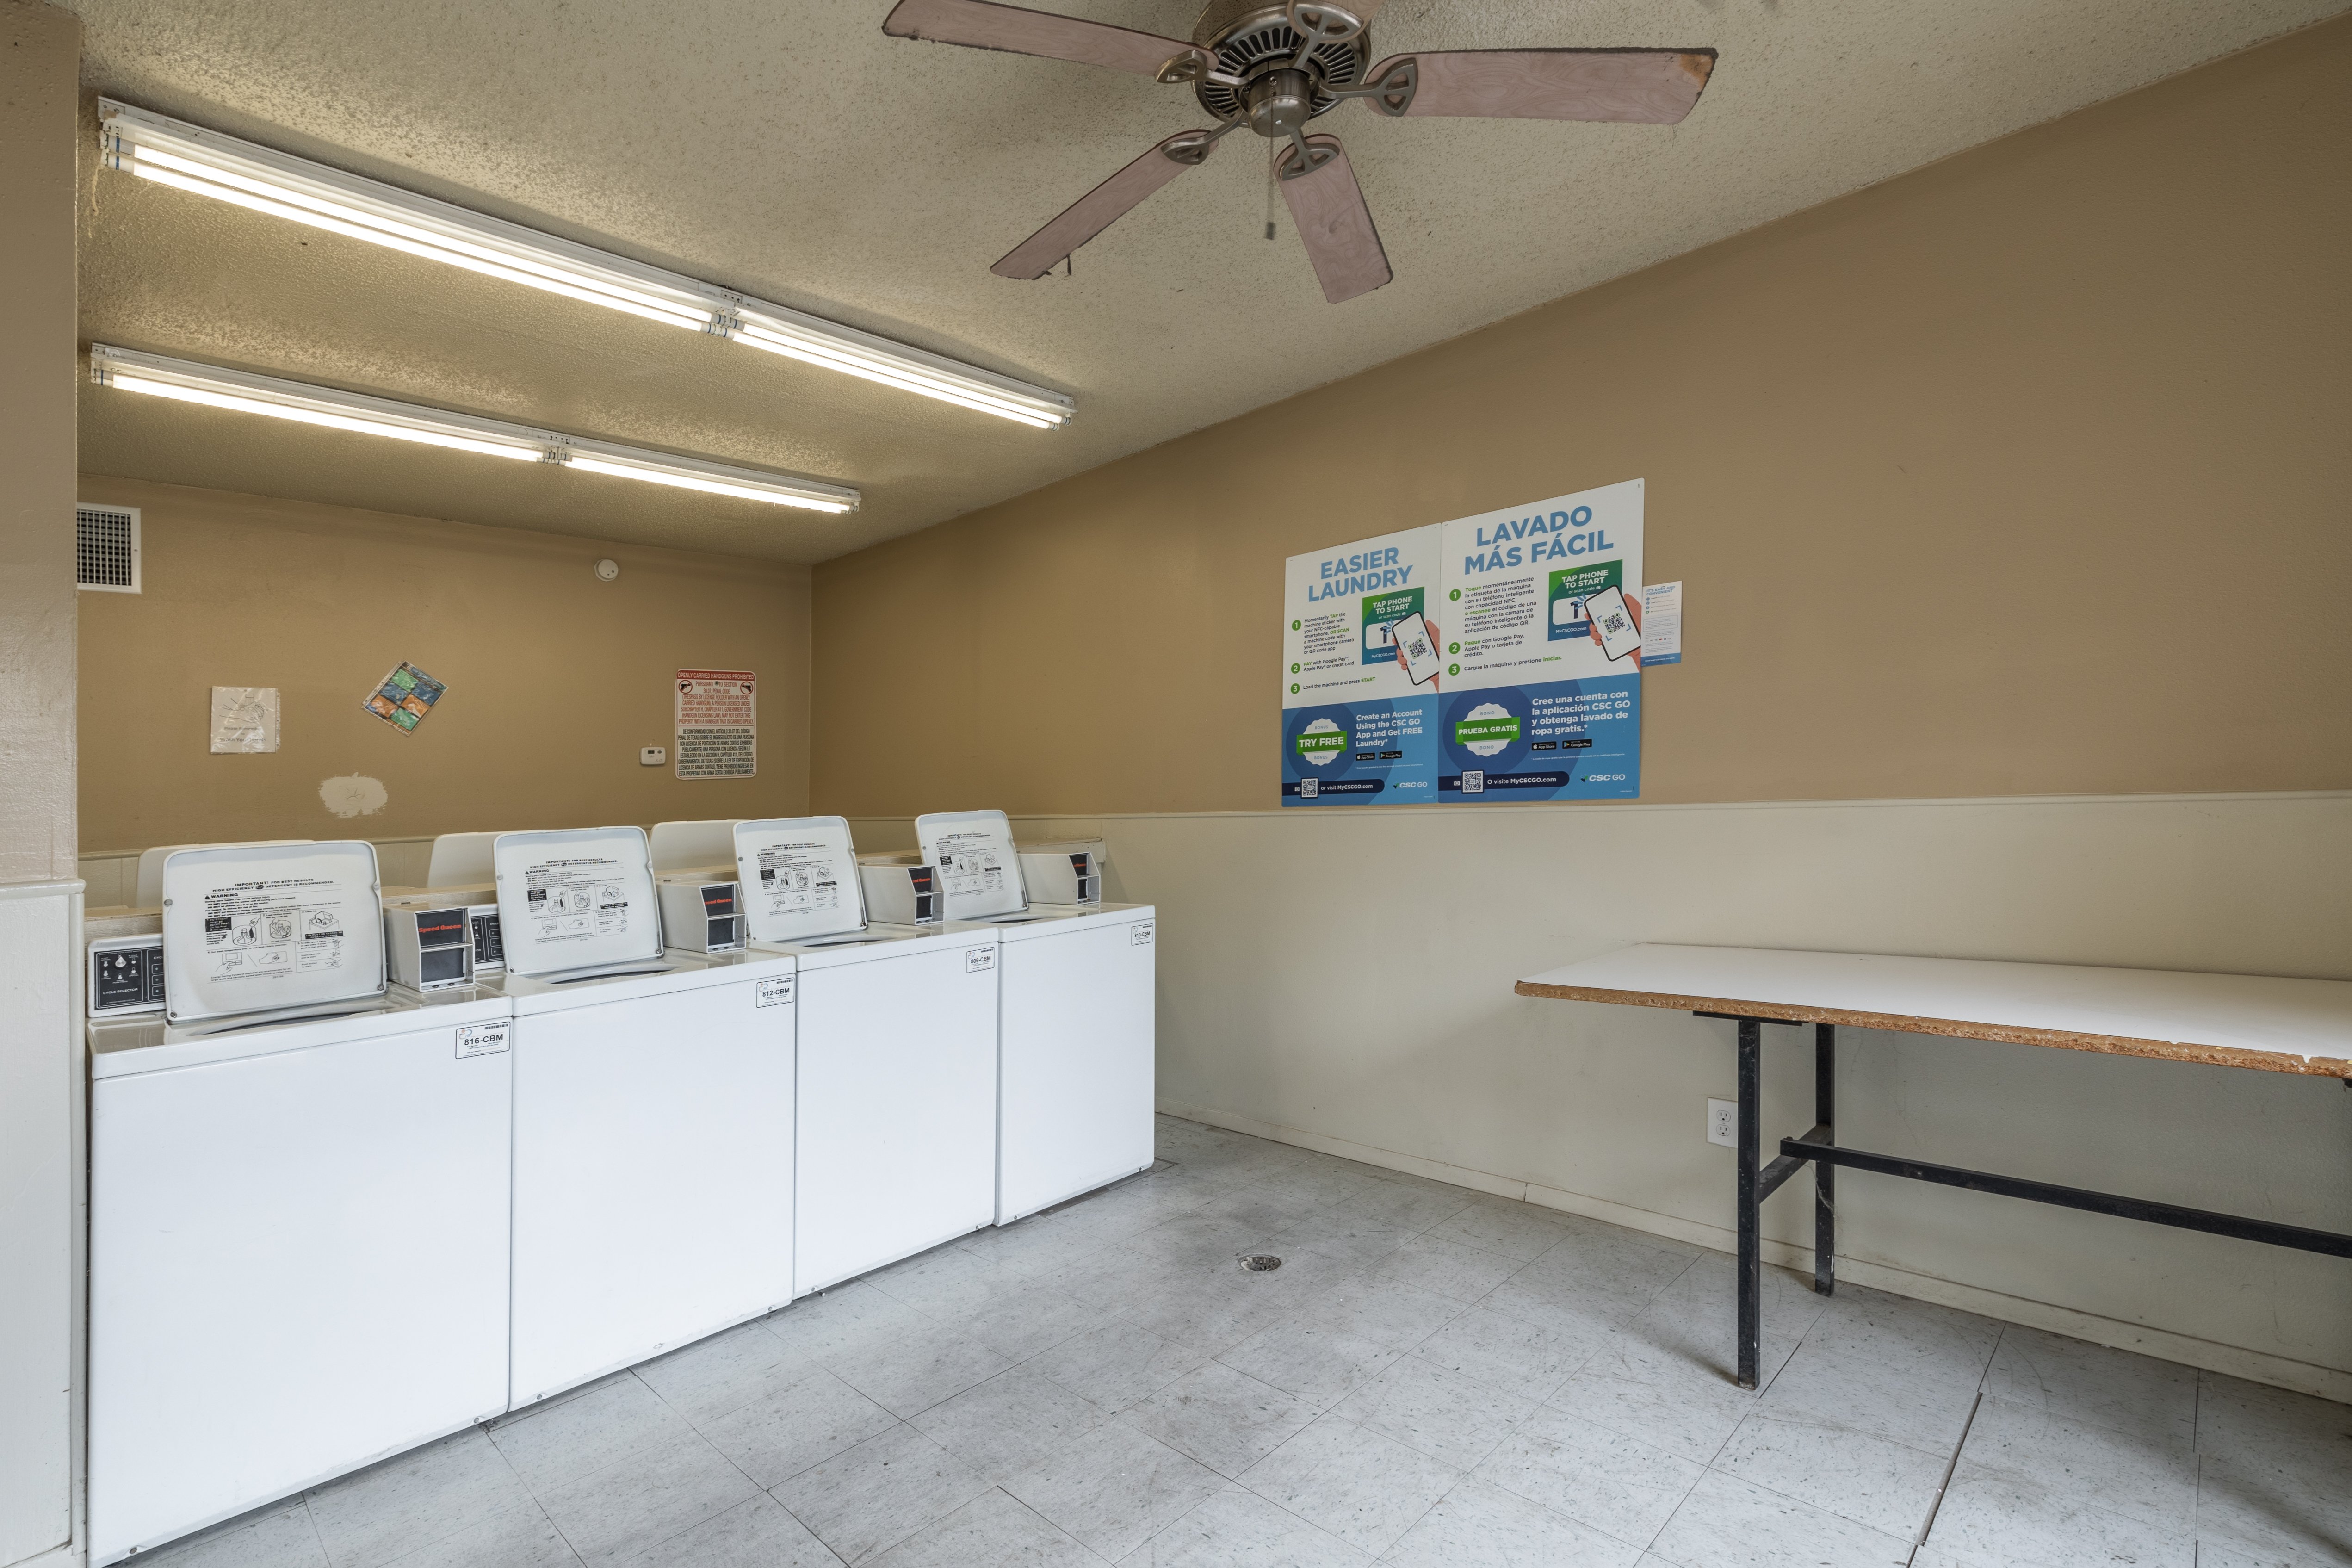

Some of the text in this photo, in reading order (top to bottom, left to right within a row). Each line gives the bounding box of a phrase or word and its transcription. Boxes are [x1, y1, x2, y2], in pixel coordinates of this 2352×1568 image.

[1477, 506, 1592, 546] LAVADO
[1465, 530, 1614, 575] MÁS FÁCIL
[1321, 547, 1398, 579] EASIER
[1562, 570, 1609, 583] TAP PHONE
[1309, 565, 1413, 602] LAUNDRY
[1483, 577, 1534, 589] momentáneamente
[1578, 577, 1605, 587] START
[1387, 596, 1412, 606] PHONE
[1386, 603, 1409, 613] START
[1575, 693, 1608, 701] cuenta
[1392, 709, 1422, 718] Account
[1542, 704, 1589, 716] aplicación
[1592, 702, 1612, 710] CSC
[1581, 713, 1613, 721] lavado
[1299, 737, 1344, 747] TRY FREE
[762, 988, 789, 997] 812-CBM
[464, 1034, 503, 1045] 816-CBM
